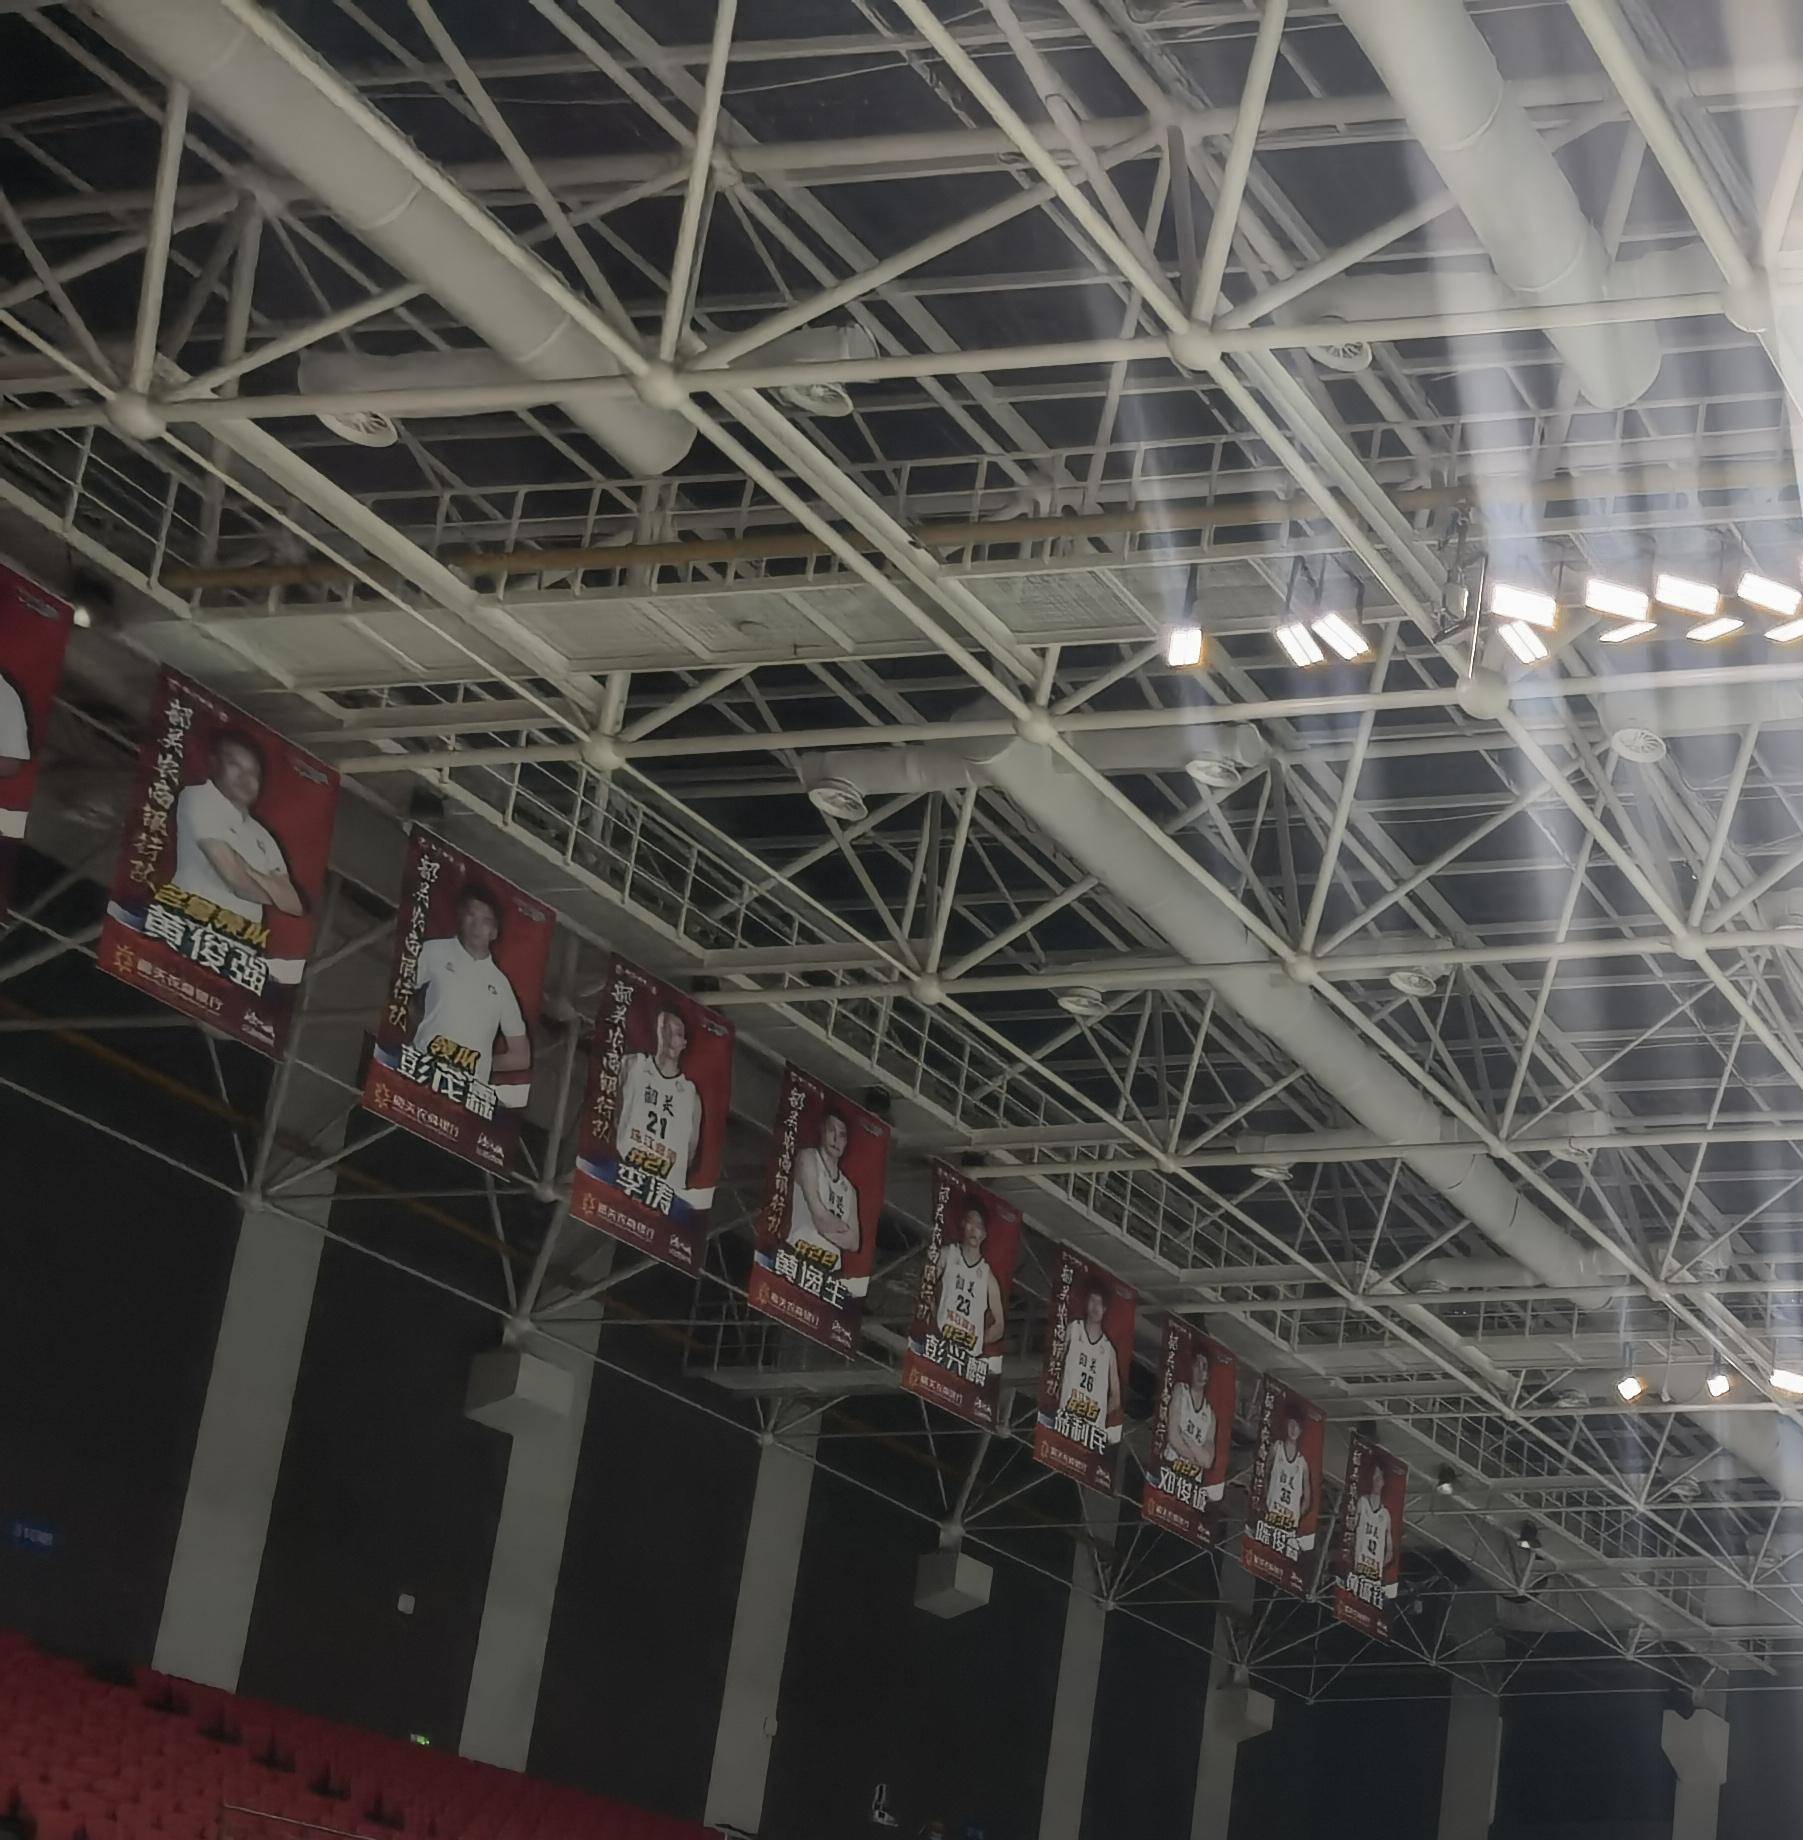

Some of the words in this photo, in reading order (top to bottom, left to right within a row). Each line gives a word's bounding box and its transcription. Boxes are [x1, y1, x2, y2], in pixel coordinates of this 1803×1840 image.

[143, 902, 269, 999] 黄俊强
[614, 1161, 675, 1217] 李涛
[956, 1295, 971, 1317] 23
[1079, 1370, 1094, 1394] 26
